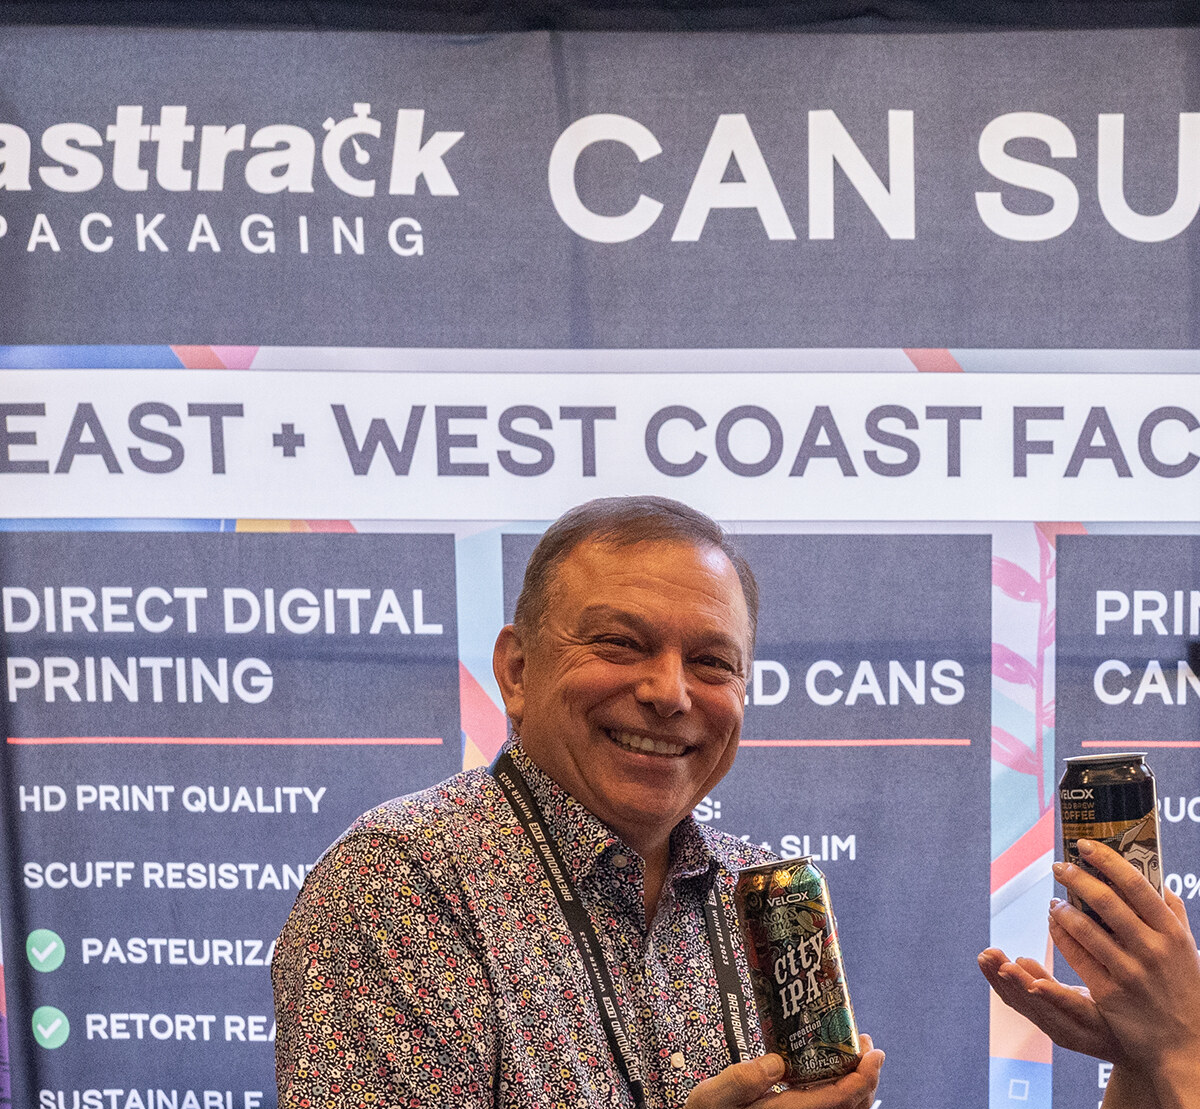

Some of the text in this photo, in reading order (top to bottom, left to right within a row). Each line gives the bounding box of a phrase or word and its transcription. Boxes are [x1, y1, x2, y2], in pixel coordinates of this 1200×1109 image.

[547, 109, 915, 244] CAN
[0, 402, 245, 475] EAST
[330, 404, 617, 478] WEST
[644, 404, 983, 479] COAST
[2, 587, 444, 635] DIRECT DIGITAL
[7, 656, 274, 704] PRINTING
[804, 660, 965, 706] CANS
[19, 785, 327, 813] HD PRINT QUALITY
[780, 835, 856, 861] SLIM
[23, 861, 135, 889] SCUFF
[766, 891, 810, 908] VELOX
[86, 1014, 216, 1040] RETORT
